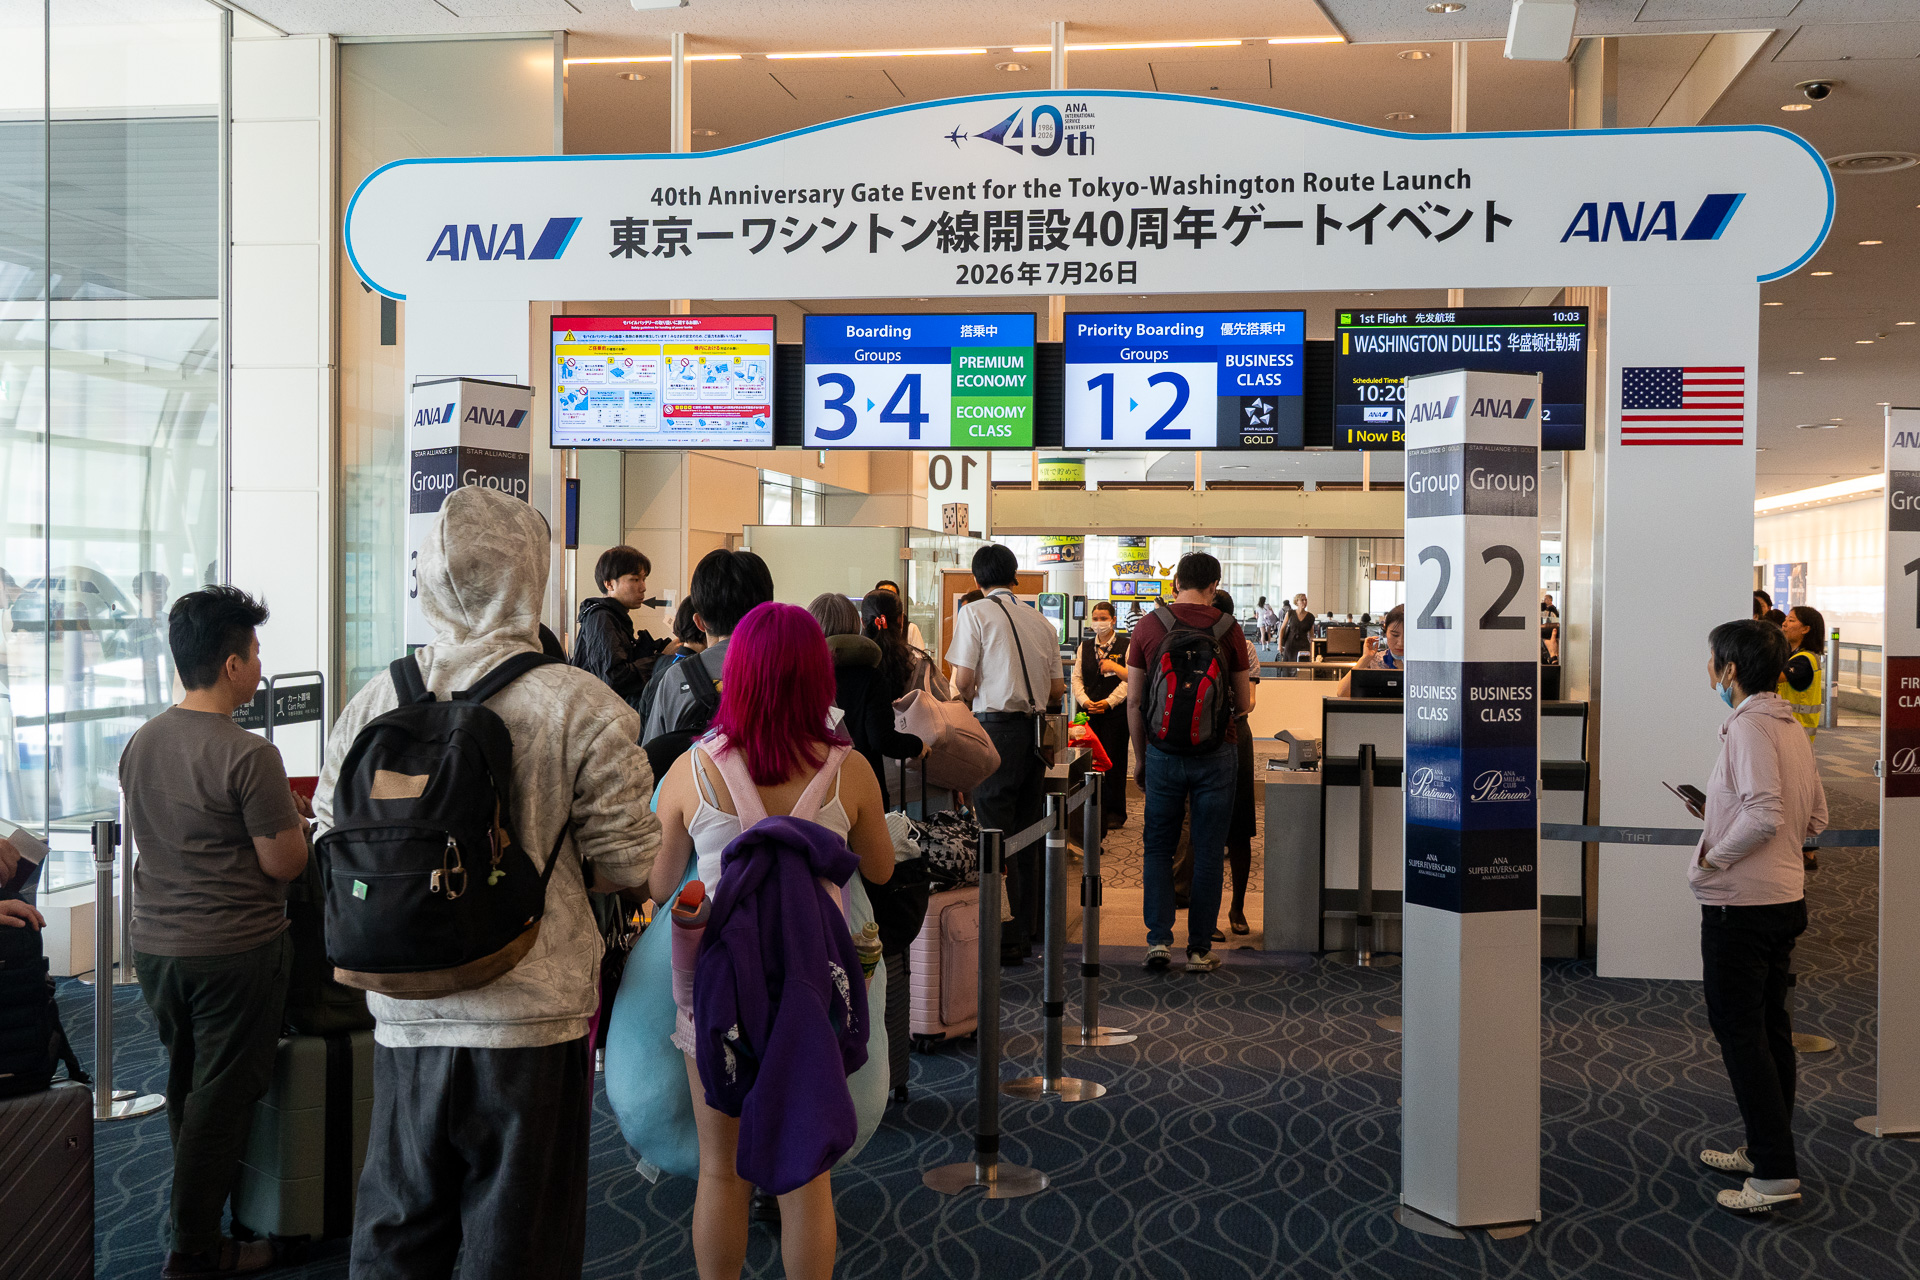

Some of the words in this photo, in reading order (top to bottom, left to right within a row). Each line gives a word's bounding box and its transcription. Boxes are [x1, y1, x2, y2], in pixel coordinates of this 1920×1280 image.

[1065, 103, 1088, 112] ANA
[650, 187, 702, 207] 40th
[708, 184, 845, 210] Anniversary
[851, 182, 904, 204] Gate
[911, 180, 976, 203] Event
[982, 178, 1017, 200] for
[1022, 177, 1063, 199] the
[1068, 173, 1295, 201] Tokyo-Washington
[1303, 171, 1375, 193] Route
[1382, 168, 1471, 190] Launch
[1560, 201, 1678, 243] ANA
[426, 223, 528, 262] ANA
[955, 260, 1138, 286] 2026年7月26日
[1359, 314, 1375, 324] 1st
[1377, 313, 1407, 325] Flight
[1415, 313, 1456, 324] 先发航班
[1552, 312, 1580, 322] 10:03
[846, 325, 912, 340] Boarding
[960, 324, 998, 338] 搭乗中
[1078, 324, 1132, 339] Priority
[1136, 323, 1204, 338] Boarding
[1220, 322, 1286, 336] 優先搭乗中
[1354, 334, 1448, 353] WASHINGTON
[1452, 334, 1501, 352] DULLES
[1507, 333, 1581, 353] 华盛顿杜勒斯
[854, 349, 902, 364] Groups
[959, 356, 1024, 369] PREMIUM
[1120, 348, 1169, 363] Groups
[1225, 354, 1294, 367] BUSINESS
[956, 374, 1027, 387] ECONOMY
[1236, 373, 1282, 386] CLASS
[1357, 385, 1405, 402] 10:20
[814, 372, 858, 441] 3
[879, 373, 930, 440] 4
[956, 406, 1026, 419] ECONOMY
[1087, 373, 1115, 440] 1
[1145, 371, 1191, 440] 2
[1410, 400, 1442, 424] ANA
[1470, 398, 1512, 418] ANA
[413, 407, 441, 428] ANA
[464, 405, 505, 427] ANA
[968, 425, 1012, 437] CLASS
[1357, 430, 1388, 442] Now
[1244, 436, 1274, 444] GOLD
[1892, 431, 1920, 448] AN
[427, 448, 448, 456] ALLIANCE
[484, 450, 516, 459] ALLIANCE
[1420, 447, 1441, 455] ALLIANCE
[412, 470, 454, 495] Group
[462, 469, 526, 499] Group
[1409, 471, 1460, 497] Group
[1470, 467, 1535, 498] Group
[1359, 556, 1370, 567] 107
[1364, 568, 1369, 579] A
[1416, 545, 1452, 630] 2
[1479, 545, 1525, 630] 2
[1410, 685, 1457, 700] BUSINESS
[1470, 687, 1532, 700] BUSINESS
[240, 708, 249, 716] Pool
[1417, 706, 1448, 721] CLASS
[1480, 708, 1522, 722] CLASS
[1410, 767, 1455, 799] Platinum
[1471, 770, 1531, 801] Platinum
[1804, 836, 1819, 844] AT
[1426, 854, 1438, 862] ANA
[1440, 864, 1456, 874] CARD
[1512, 864, 1533, 873] CARD
[1749, 1205, 1771, 1213] SPORT
